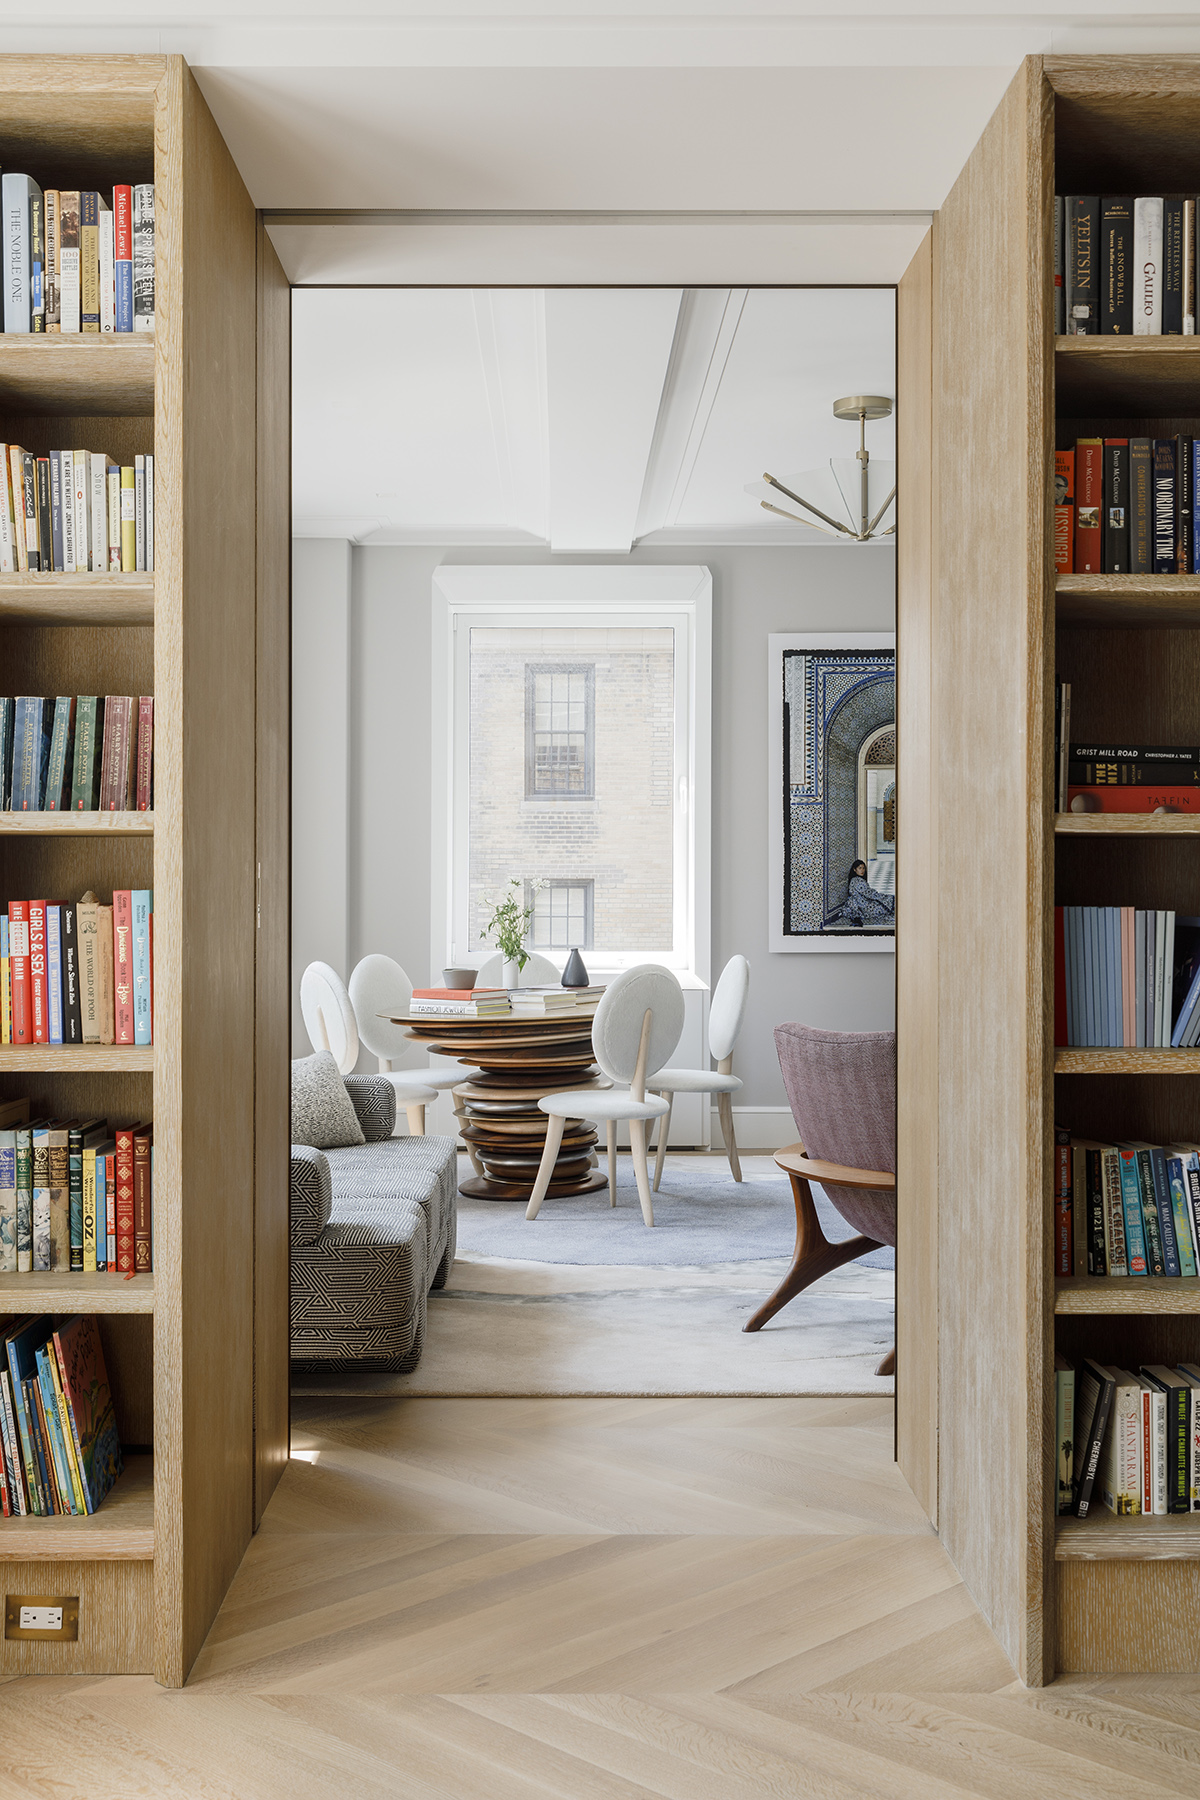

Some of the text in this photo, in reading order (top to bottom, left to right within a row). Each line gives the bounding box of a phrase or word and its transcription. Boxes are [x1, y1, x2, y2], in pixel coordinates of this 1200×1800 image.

[118, 193, 127, 256] Michael Lewis
[11, 208, 22, 303] THE NOBLE ONE
[141, 191, 153, 295] BRUCE SPRINGSTEEN
[1077, 215, 1091, 289] YELTSIN
[84, 265, 89, 276] OF
[1143, 262, 1156, 316] GALILEO
[94, 473, 104, 496] Snow
[1113, 468, 1121, 504] McCULLOUGH
[1137, 465, 1146, 564] CONVERSATIONS WITH MYSELF
[1156, 478, 1174, 560] NO ORDINARY TIME
[1055, 508, 1069, 564] KISSINGER
[82, 722, 90, 753] HARRY
[1076, 748, 1098, 756] GRIST
[1098, 749, 1116, 757] MILL
[54, 756, 63, 786] POTTER
[1096, 763, 1106, 784] THE
[1107, 763, 1117, 784] NIX
[48, 914, 59, 942] RAISING
[65, 910, 73, 934] Silverstein
[13, 906, 24, 980] THE TEENAGE BRAIN
[30, 908, 44, 976] GIRLS & SEX
[85, 939, 93, 956] THE
[50, 950, 59, 963] SON
[87, 987, 95, 998] OF
[1189, 1173, 1200, 1200] BRIGHT
[84, 1206, 89, 1215] of
[1109, 1154, 1125, 1265] MICHAEL CHABON
[1161, 1207, 1170, 1222] MAN
[84, 1215, 94, 1240] OZ
[1149, 1217, 1160, 1262] GEORGE SAUNDERS
[1164, 1223, 1173, 1245] CALLED
[1166, 1247, 1175, 1259] OVE
[1178, 1390, 1186, 1402] TOM
[1178, 1403, 1186, 1420] WOLFE
[1178, 1428, 1186, 1437] AM
[1086, 1440, 1101, 1481] CHERNOBYL
[1126, 1412, 1137, 1490] SHANTARAM
[1178, 1438, 1186, 1468] CHARLOTTE
[1177, 1470, 1186, 1497] SIMMONS
